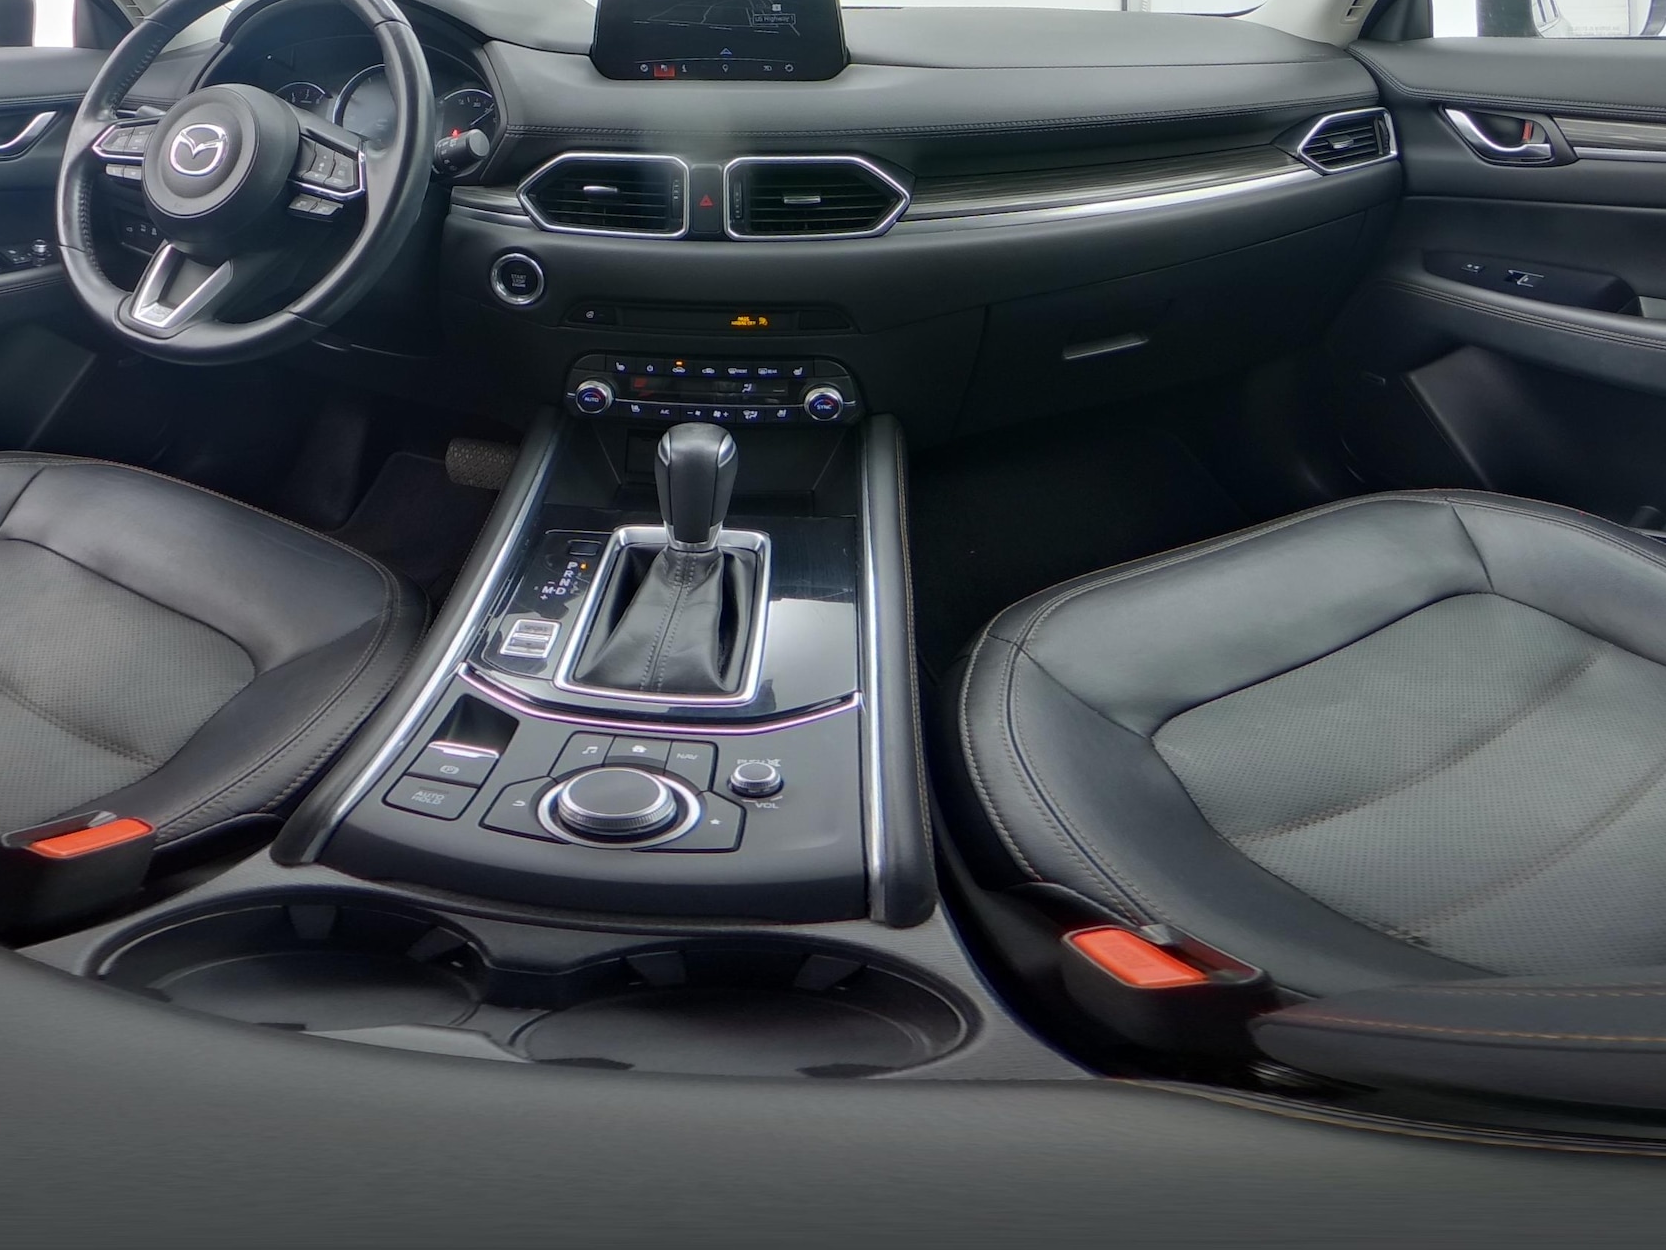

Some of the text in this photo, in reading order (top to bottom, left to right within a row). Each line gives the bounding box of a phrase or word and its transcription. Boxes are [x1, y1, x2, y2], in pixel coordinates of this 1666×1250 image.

[567, 561, 578, 569] P
[563, 570, 574, 578] R
[559, 578, 571, 586] N
[414, 790, 445, 800] AUTO
